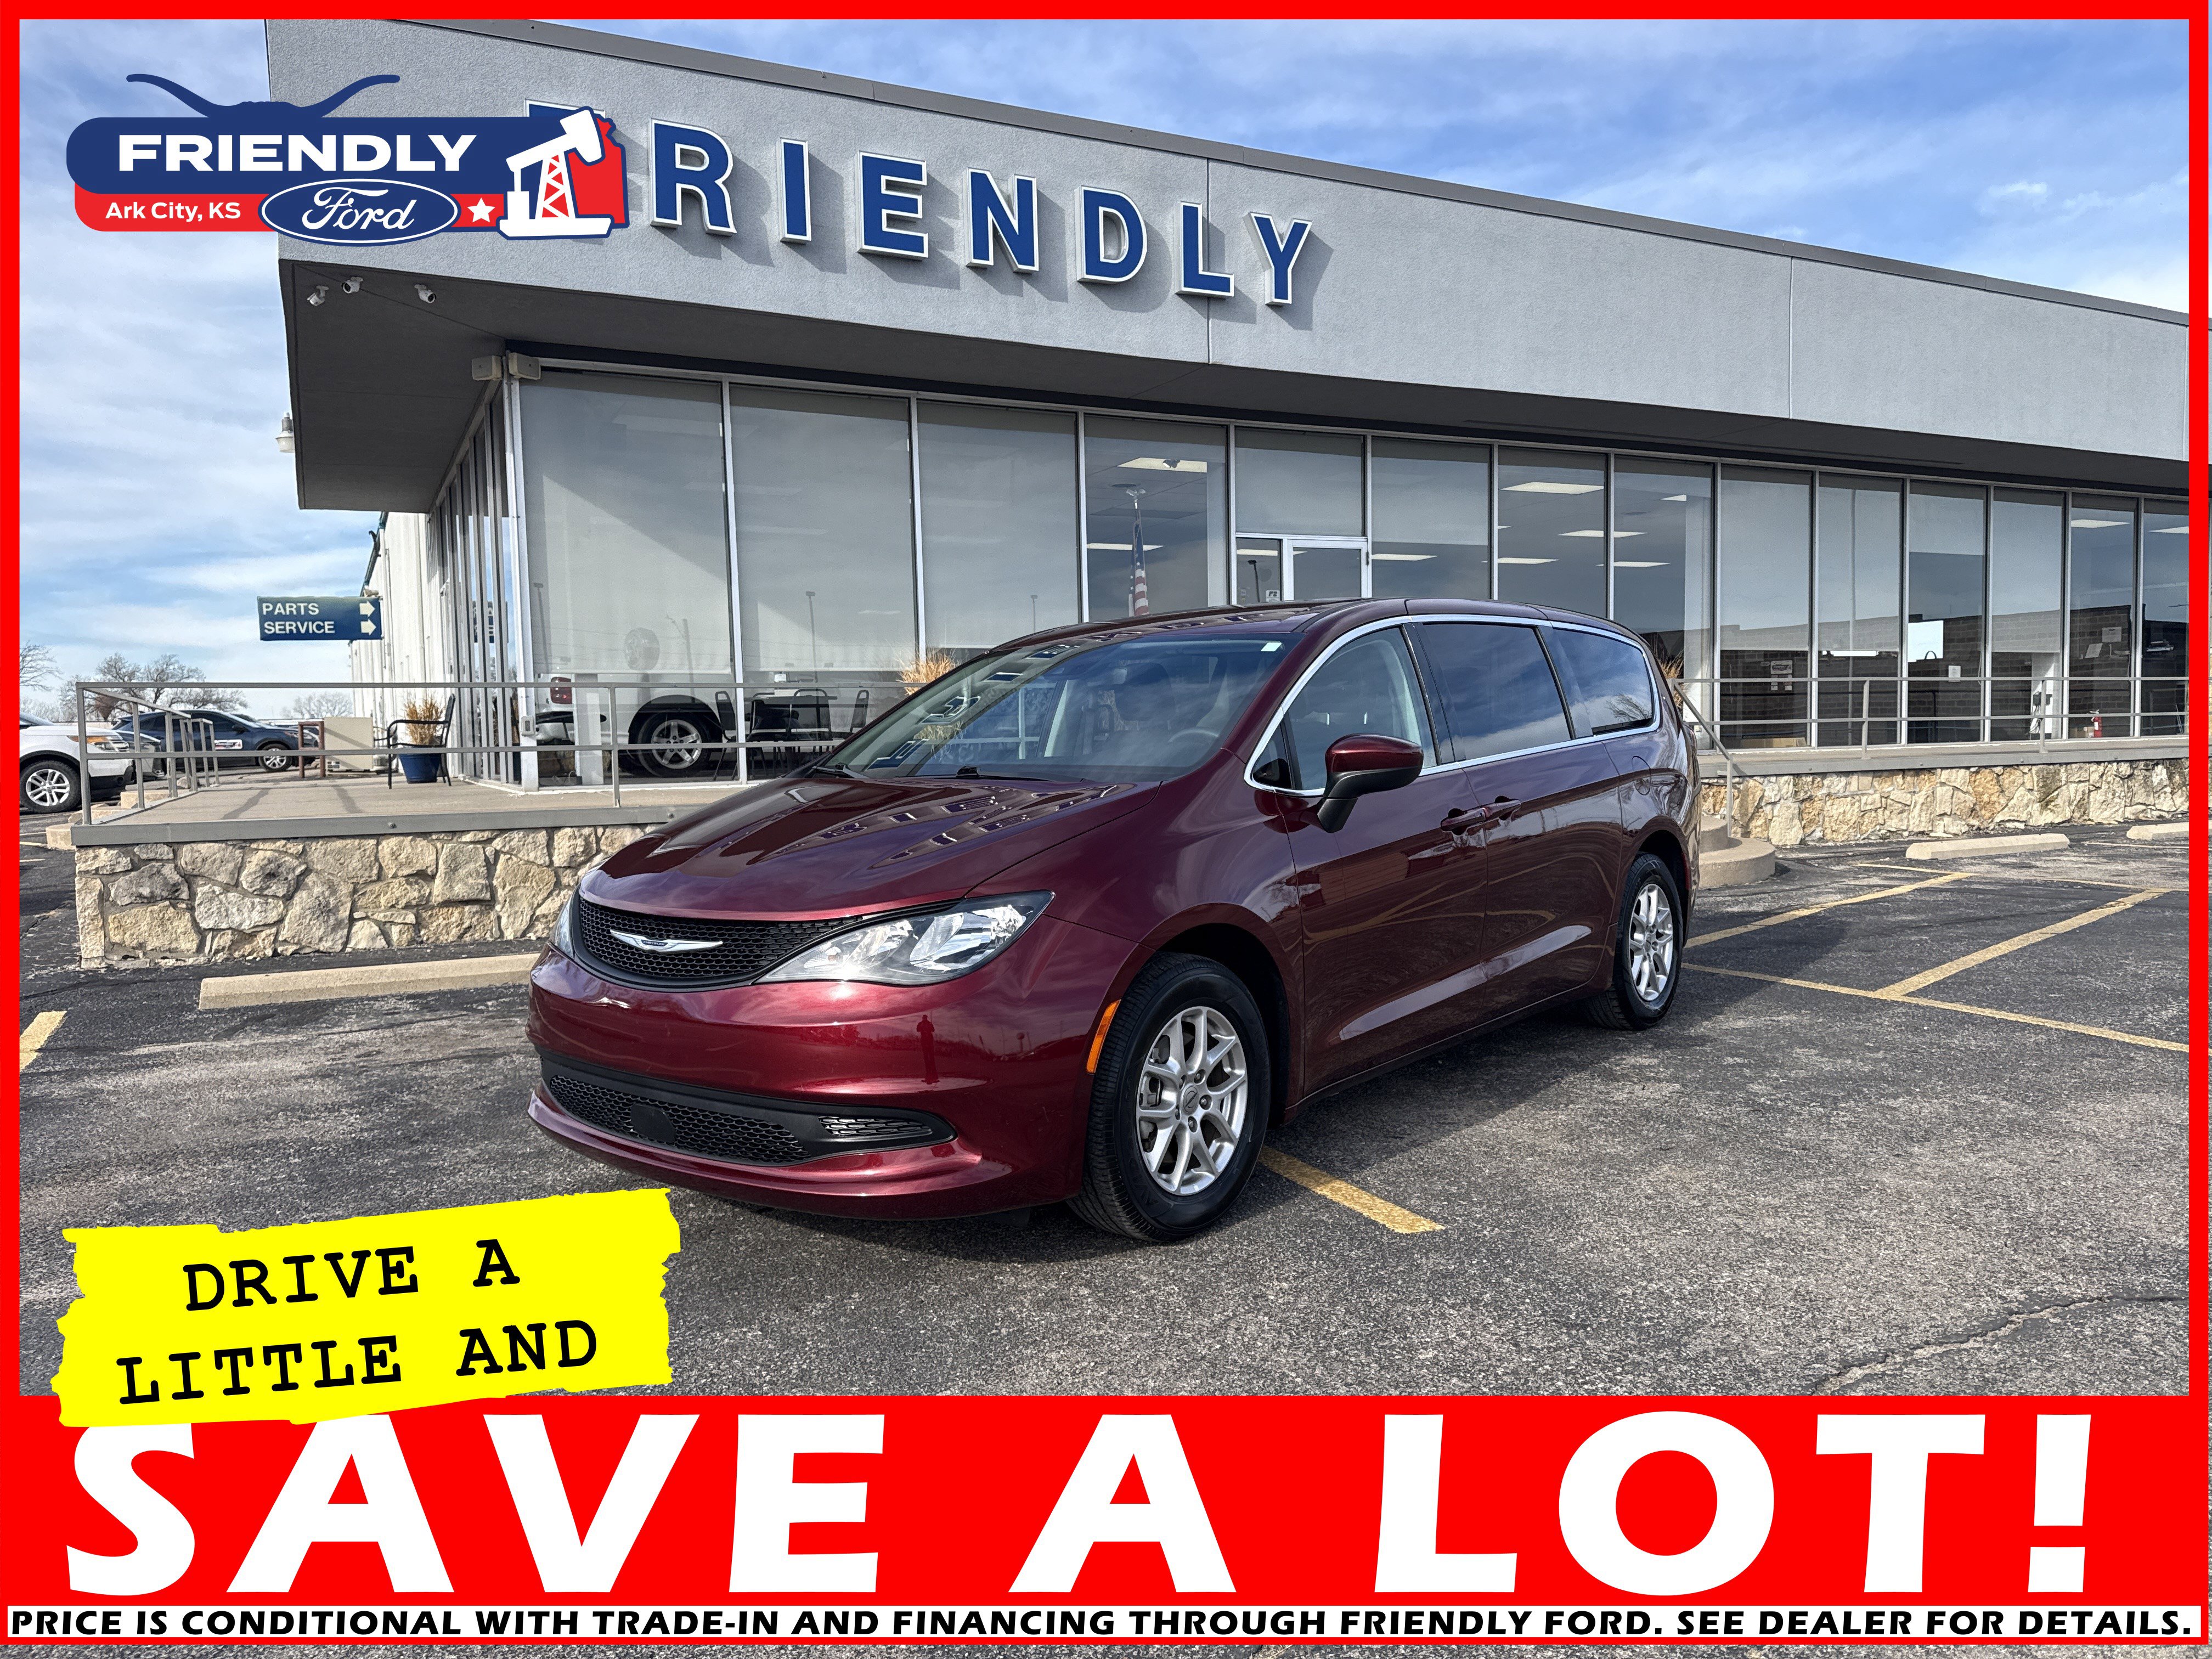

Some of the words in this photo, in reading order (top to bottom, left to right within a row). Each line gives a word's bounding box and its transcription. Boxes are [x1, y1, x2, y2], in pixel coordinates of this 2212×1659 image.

[524, 99, 1313, 306] RIENDLY
[262, 602, 319, 616] PARTS
[264, 621, 335, 634] SERVICE
